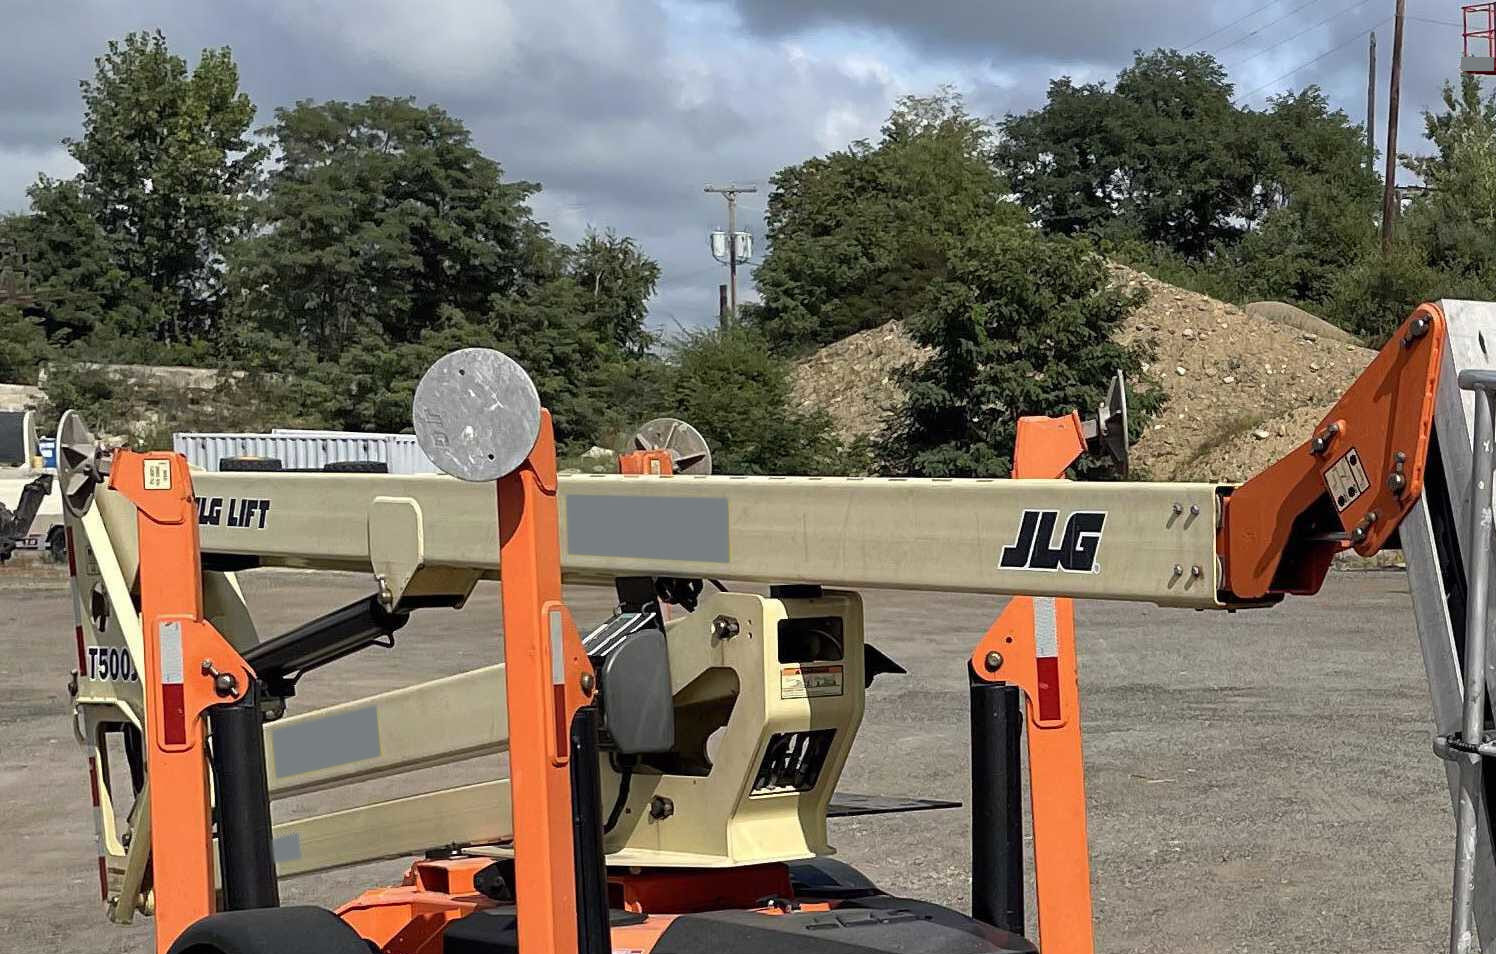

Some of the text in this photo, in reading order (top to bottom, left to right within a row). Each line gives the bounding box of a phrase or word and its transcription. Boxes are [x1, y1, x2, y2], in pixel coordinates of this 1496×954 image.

[227, 498, 270, 529] LIFT
[999, 509, 1108, 574] JLG
[88, 647, 138, 682] T500
